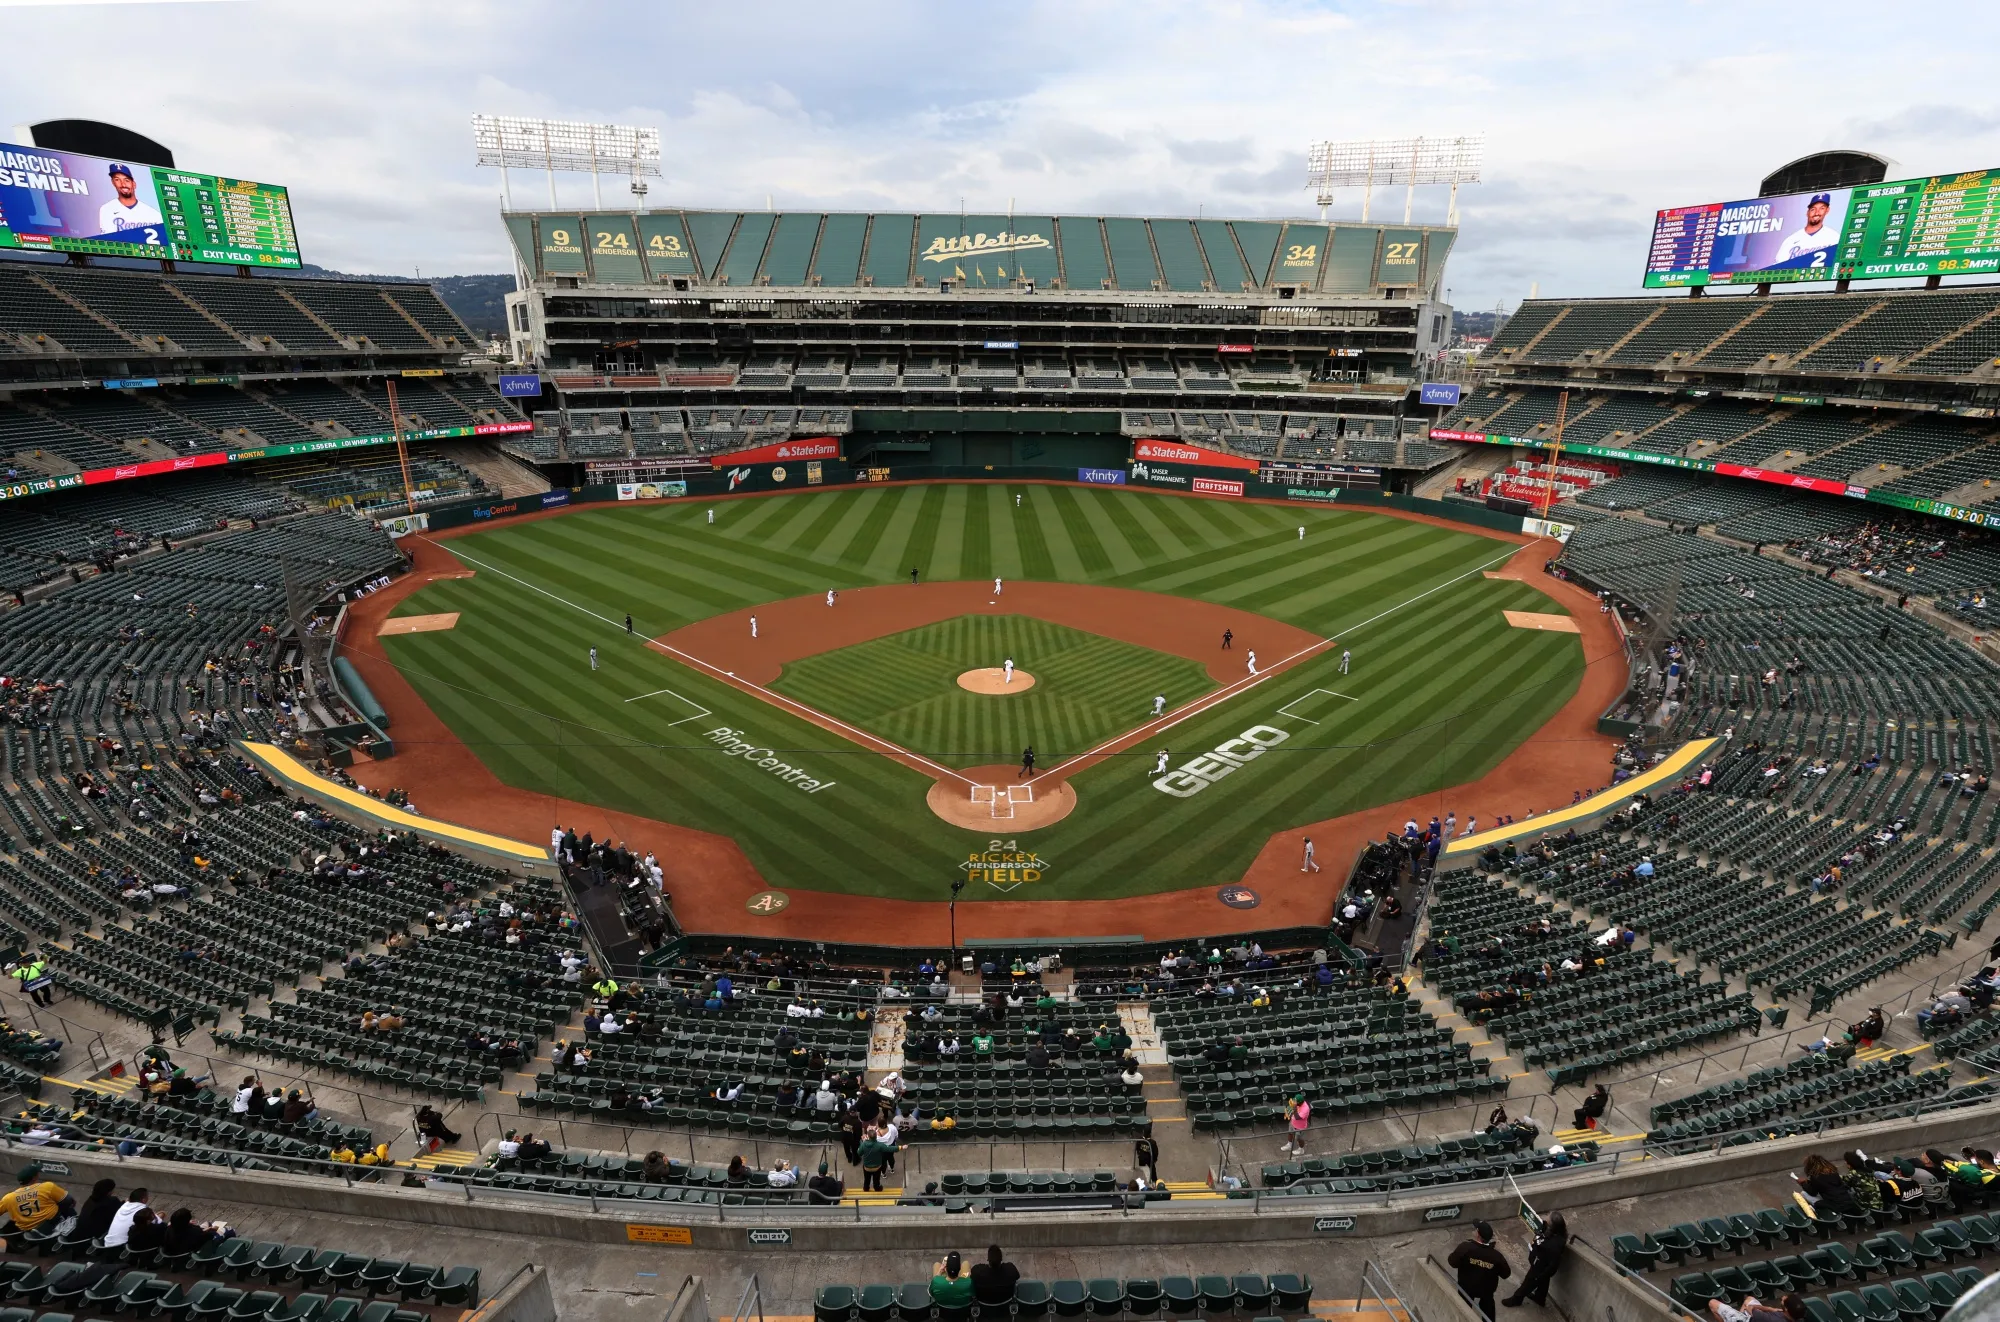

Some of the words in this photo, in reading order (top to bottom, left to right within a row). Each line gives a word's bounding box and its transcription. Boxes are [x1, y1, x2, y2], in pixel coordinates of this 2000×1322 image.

[0, 168, 89, 195] SEMIEN
[180, 176, 201, 185] SEASON
[1954, 171, 1988, 183] Athletics
[1881, 186, 1906, 196] SEASON
[1937, 181, 1980, 192] LAUREANO
[1934, 190, 1967, 198] LOWRIE
[1675, 206, 1709, 215] RANGERS
[1721, 204, 1770, 222] MARCUS
[1930, 204, 1966, 213] MURPHY
[234, 218, 269, 226] BETHANCOURT
[1717, 218, 1783, 236] SEMIEN
[1926, 217, 1978, 227] BETHANCOURT
[144, 228, 160, 244] 2
[552, 230, 570, 246] 9
[596, 232, 629, 249] 24
[544, 245, 581, 253] JACKSON
[650, 235, 681, 251] 43
[921, 232, 1050, 261] Athletics
[203, 250, 224, 259] EXIT
[226, 252, 254, 261] VELO:
[593, 248, 637, 256] HENDERSON
[1286, 245, 1316, 260] 34
[1386, 243, 1419, 258] 27
[1810, 251, 1827, 268] 2
[1865, 264, 1892, 274] EXIT
[1894, 262, 1928, 272] VELO:
[120, 380, 143, 388] Corona
[506, 381, 535, 391] xfinity
[1427, 389, 1454, 400] xfinity
[238, 451, 265, 460] MONTAS
[1085, 470, 1118, 483] xfinity
[1151, 475, 1185, 483] PERMANENTE
[34, 483, 50, 491] TEX
[59, 479, 76, 487] OAK
[1196, 482, 1240, 492] CRAFTSMAN
[1505, 484, 1548, 497] Budweiser
[543, 495, 565, 504] Southwest
[1845, 490, 1866, 498] ATHLETICS
[473, 503, 517, 518] RingCentral
[395, 520, 406, 529] 811
[702, 727, 836, 794] RingCentral
[1152, 725, 1290, 797] GEICO
[989, 840, 1017, 852] 24
[970, 854, 1037, 862] RICKEY
[969, 869, 1041, 882] FIELD
[748, 895, 783, 911] A's
[16, 1191, 38, 1202] BUSH
[19, 1200, 40, 1216] 51
